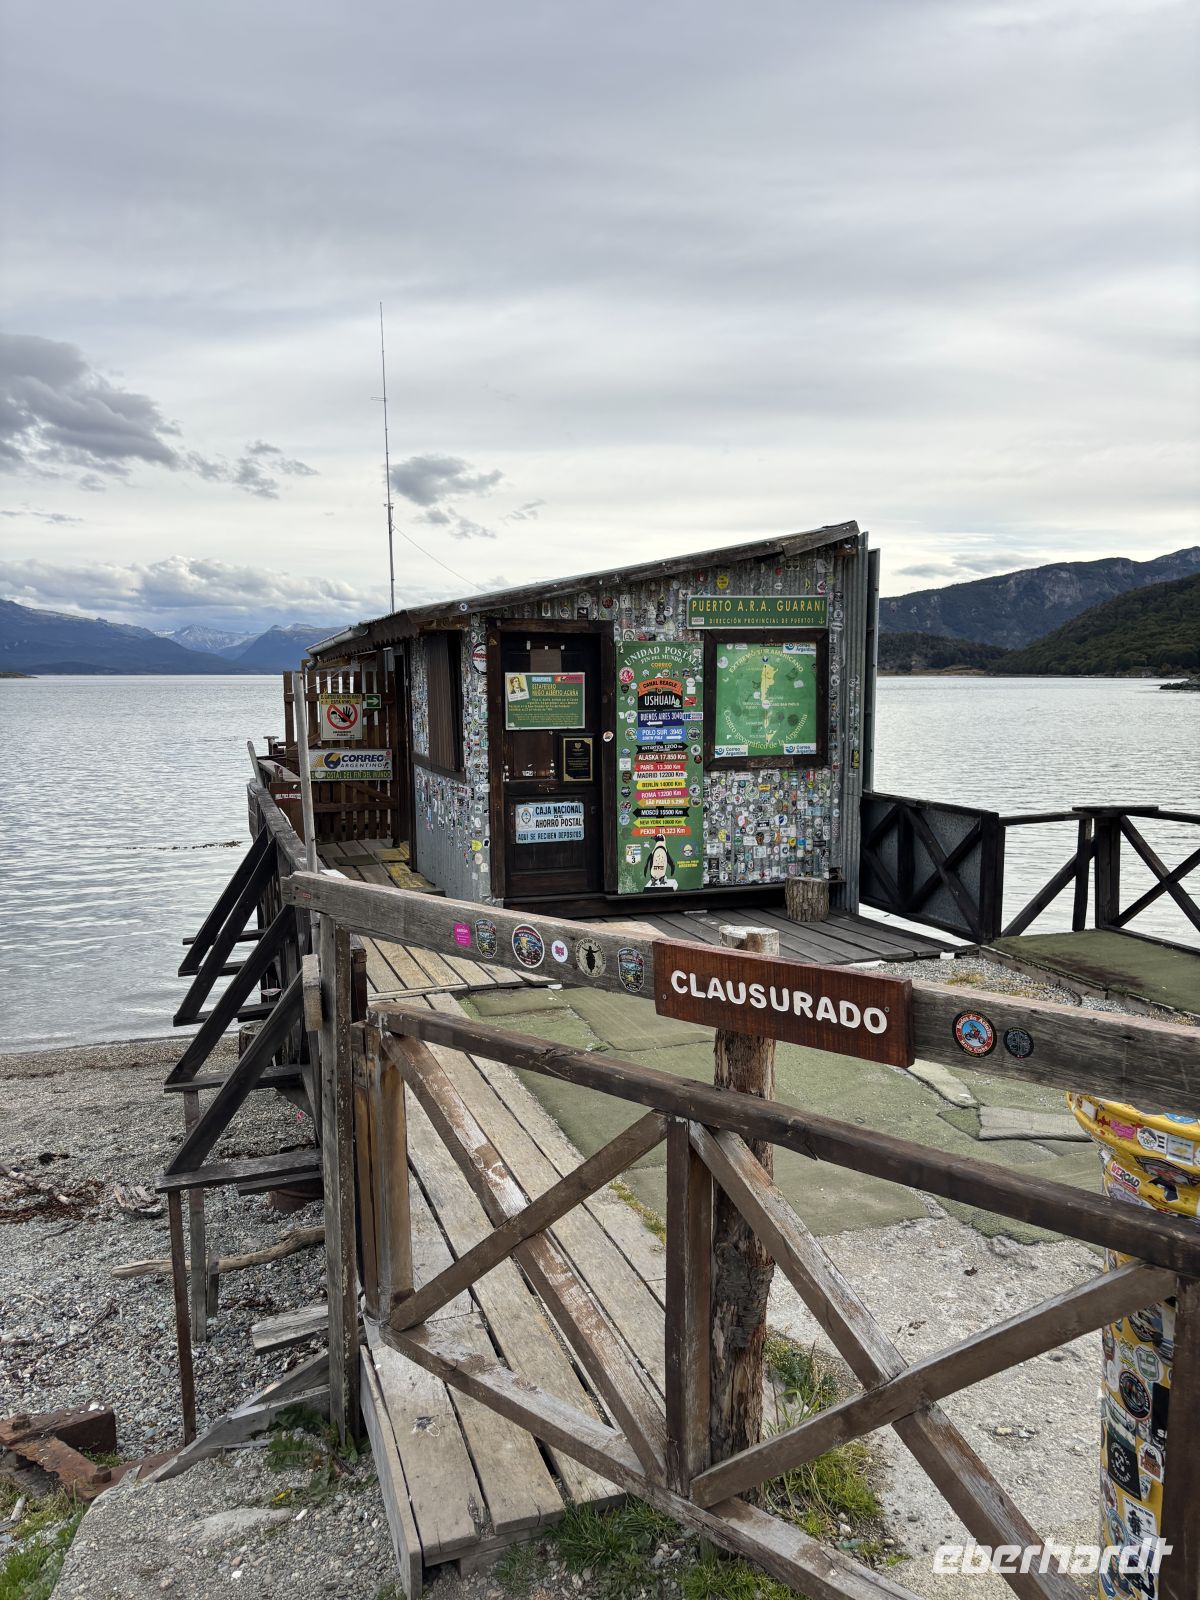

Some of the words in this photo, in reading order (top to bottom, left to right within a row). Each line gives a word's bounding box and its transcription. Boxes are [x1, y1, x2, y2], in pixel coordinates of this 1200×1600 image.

[692, 600, 731, 612] PUERTO
[738, 600, 771, 612] A.R.A.
[624, 646, 660, 666] UNIDAD
[665, 646, 698, 666] POSTAL
[662, 654, 683, 663] MUNDO
[643, 680, 659, 688] CANAL
[660, 680, 678, 688] BEAGLE
[644, 695, 675, 706] USHUAIA
[640, 713, 658, 721] BUENOS
[724, 710, 736, 733] Centro
[785, 714, 808, 741] Argentina
[341, 754, 384, 762] CORREO
[324, 771, 342, 779] OSTAL
[535, 806, 552, 815] CAJA
[554, 805, 582, 815] NACIONAL
[535, 819, 559, 828] AHORRO
[560, 817, 582, 827] POSTAL
[670, 970, 888, 1034] CLAUSURADO
[1111, 1163, 1140, 1188] WEROAD
